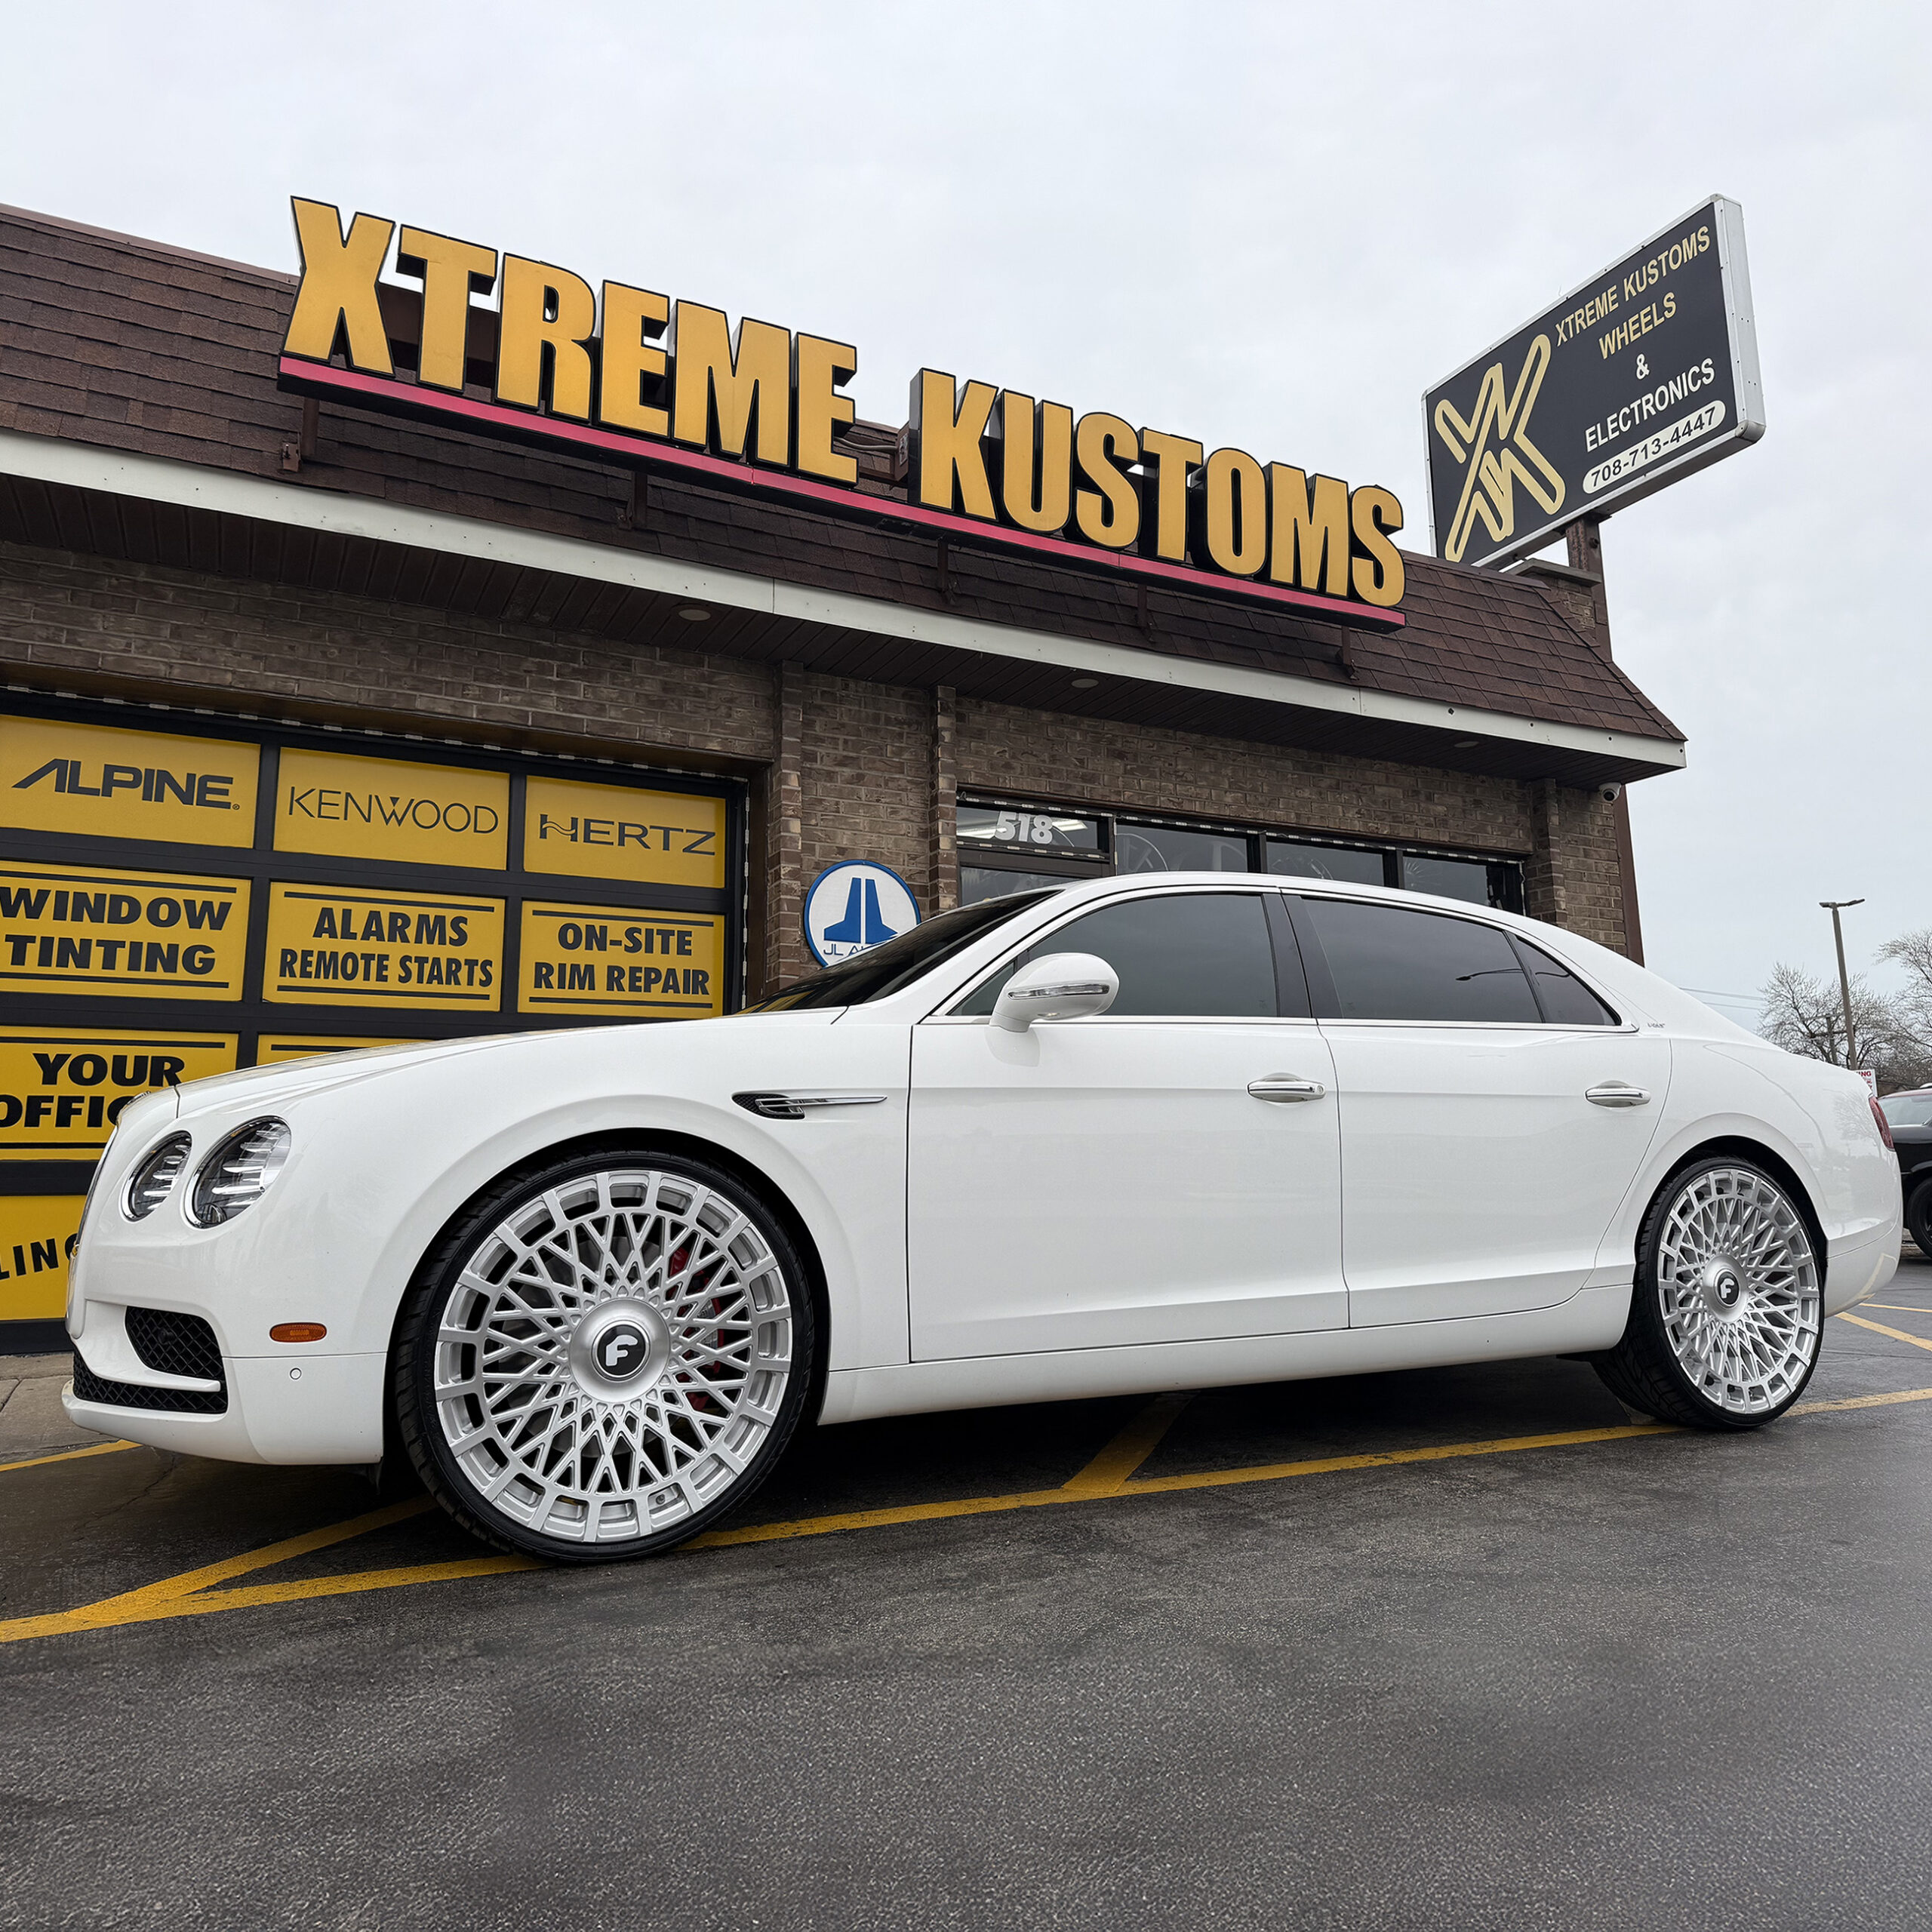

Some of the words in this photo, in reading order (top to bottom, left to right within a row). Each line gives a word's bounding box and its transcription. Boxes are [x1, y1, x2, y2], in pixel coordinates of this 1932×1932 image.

[1555, 285, 1620, 347] XTREME
[1623, 226, 1711, 302] KUSTOMS
[1598, 292, 1677, 359] WHEELS
[1635, 353, 1651, 380] &
[282, 195, 858, 486] XTREME
[910, 368, 1406, 607] KUSTOMS
[1585, 358, 1715, 452] ELECTRONICS
[1590, 406, 1716, 487] 708-713-4447
[12, 758, 234, 810] ALPINE
[288, 786, 499, 834] KENWOOD
[995, 811, 1054, 844] 518
[539, 814, 716, 856] HERTZ
[0, 886, 232, 931] WINDOW
[312, 906, 468, 946] ALARMS
[4, 934, 216, 975] TINTING
[557, 922, 693, 956] ON-SITE
[823, 943, 844, 955] JL
[279, 948, 389, 983] REMOTE
[397, 954, 494, 987] STARTS
[534, 961, 596, 991] RIM
[605, 965, 710, 995] REPAIR
[32, 1053, 186, 1087] YOUR
